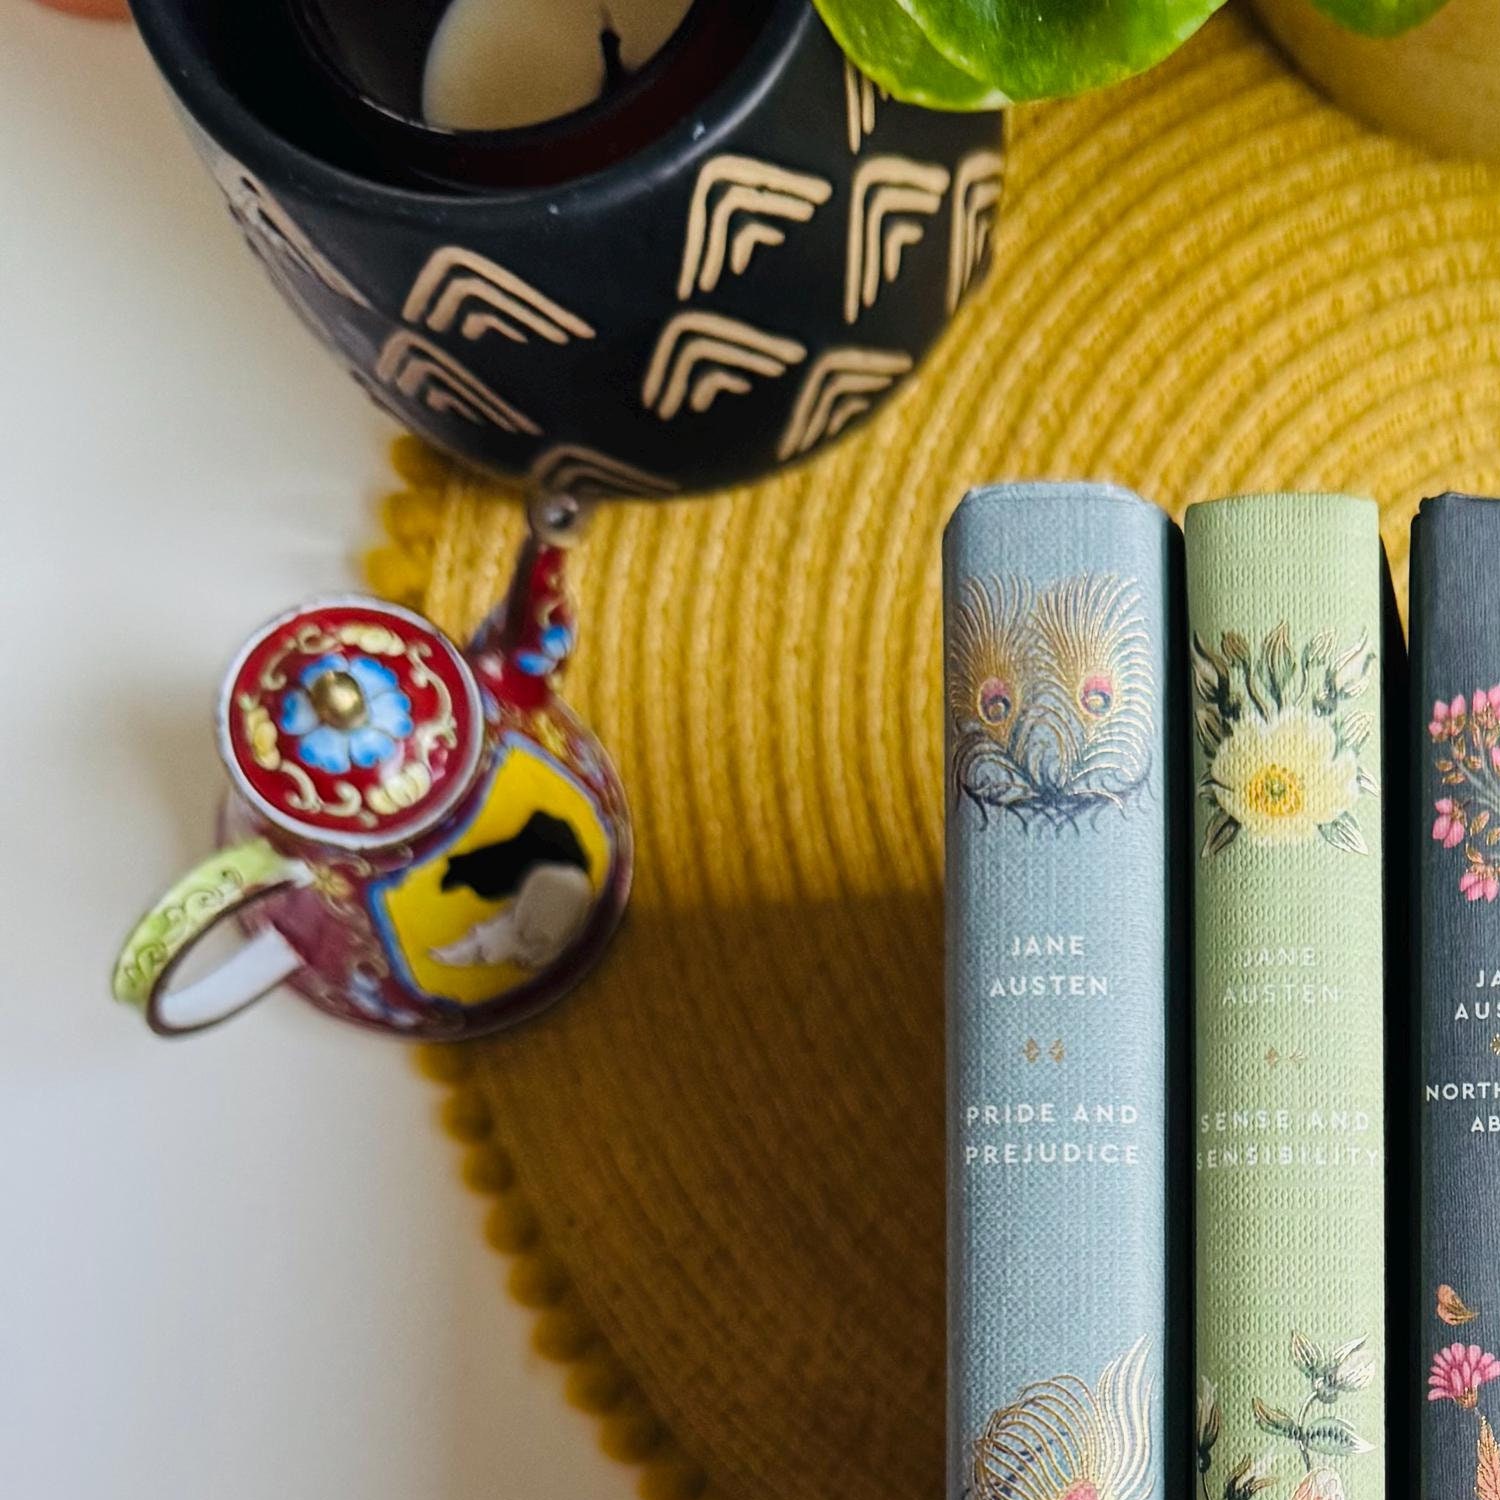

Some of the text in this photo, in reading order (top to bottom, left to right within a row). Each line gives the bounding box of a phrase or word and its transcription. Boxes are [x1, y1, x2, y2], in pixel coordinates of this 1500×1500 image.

[1011, 935, 1085, 957] JANE
[1242, 947, 1317, 968] JANE
[989, 975, 1109, 998] AUSTEN
[1222, 983, 1341, 1006] AUSTEN
[966, 1103, 1139, 1125] PRIDE AND
[1200, 1109, 1369, 1133] SENSE AND
[965, 1143, 1140, 1165] PREJUDICE
[1196, 1146, 1379, 1171] SENSIBILITY
